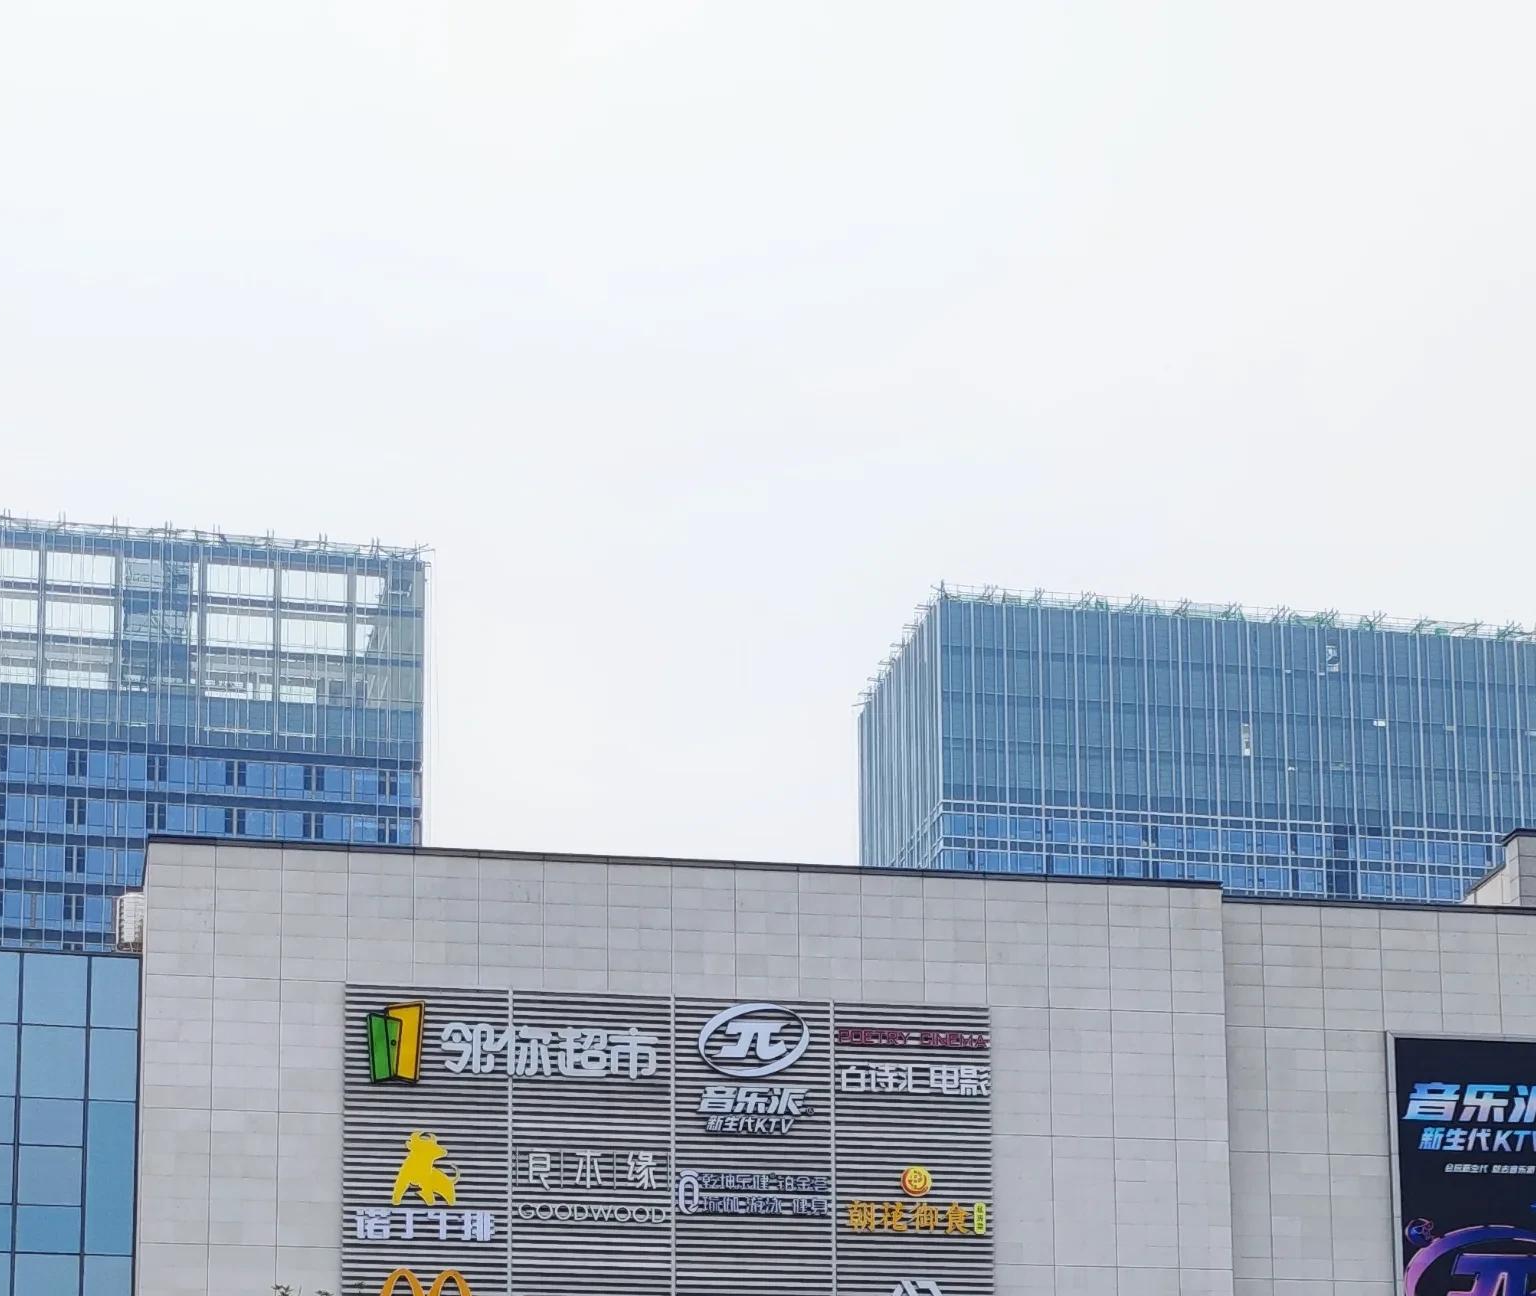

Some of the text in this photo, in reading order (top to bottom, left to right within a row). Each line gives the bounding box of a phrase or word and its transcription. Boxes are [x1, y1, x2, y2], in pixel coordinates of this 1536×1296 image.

[837, 1029, 989, 1049] POETRY CINEMA
[697, 1086, 810, 1115] 音乐派
[705, 1116, 794, 1134] 新生代KTV
[355, 1208, 496, 1241] 诺丁牛排
[518, 1203, 666, 1224] GOODWOOD
[847, 1200, 969, 1234] 朝花御食
